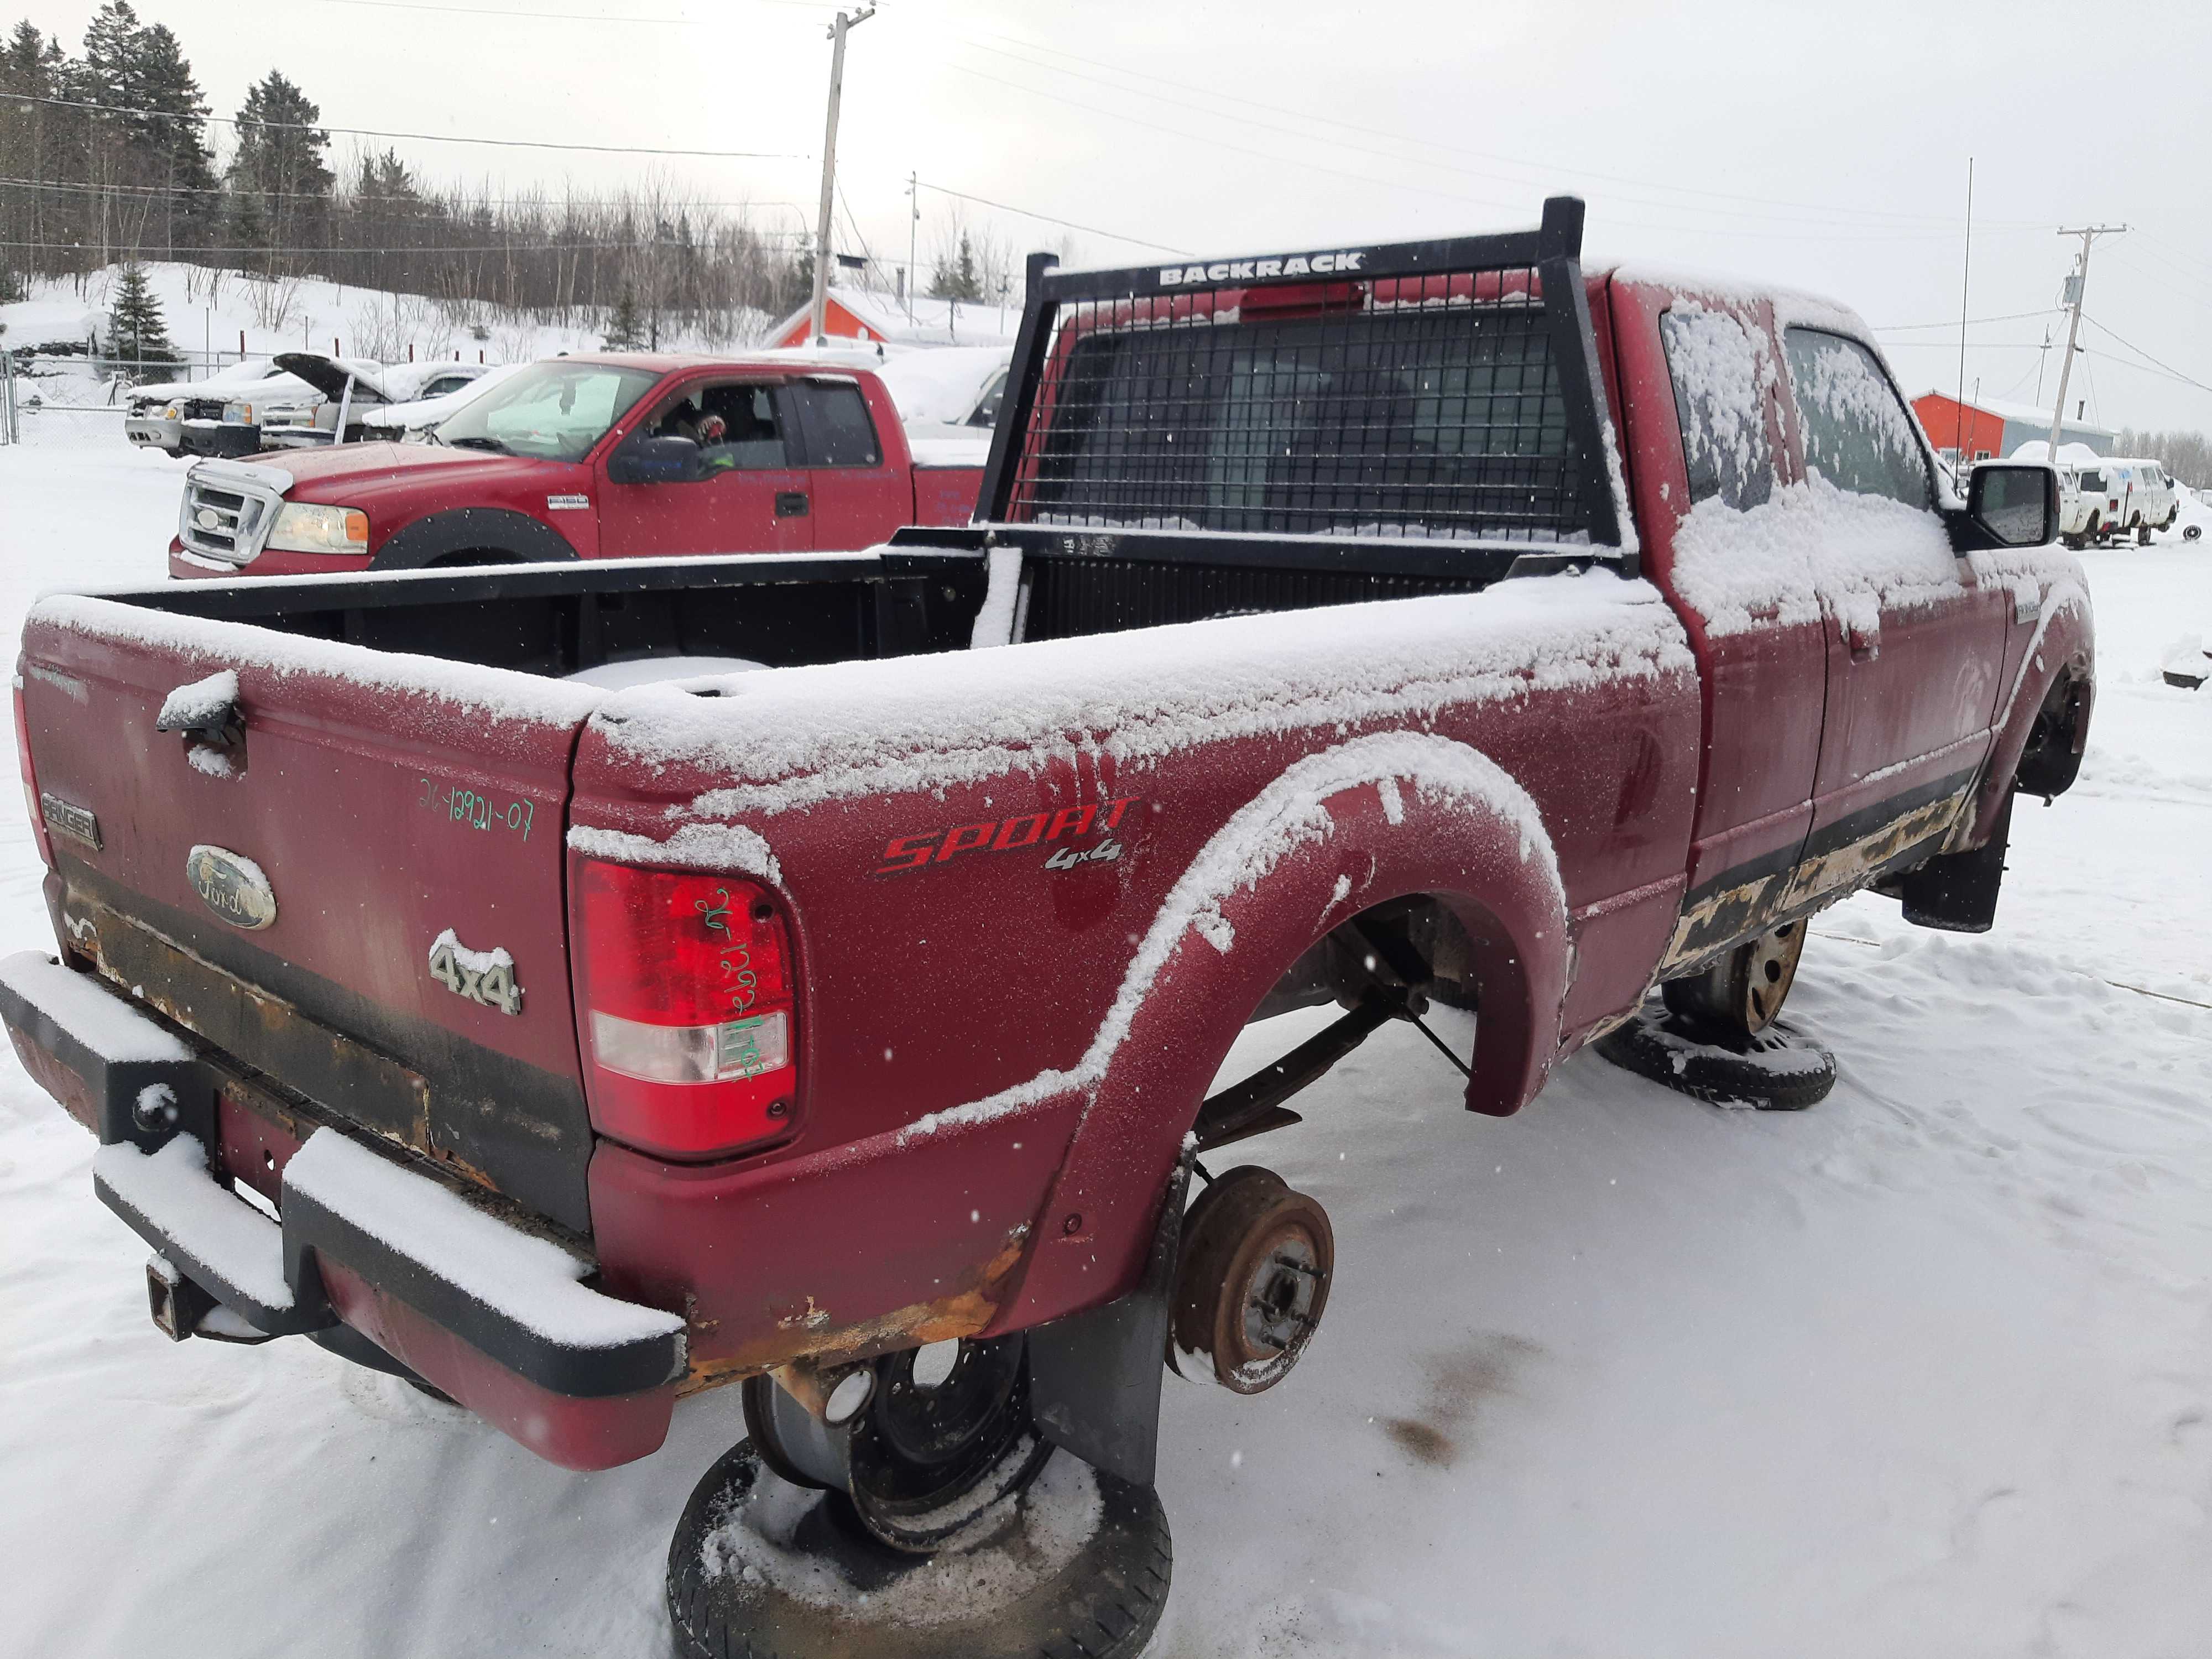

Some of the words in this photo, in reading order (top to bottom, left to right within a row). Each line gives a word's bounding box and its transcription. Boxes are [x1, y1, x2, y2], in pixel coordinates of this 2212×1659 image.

[1159, 252, 1362, 286] BACKRACK
[42, 796, 93, 839] RANGER
[875, 796, 1141, 874] SPORT
[1044, 838, 1123, 870] 4x4
[429, 943, 520, 1016] 4x4
